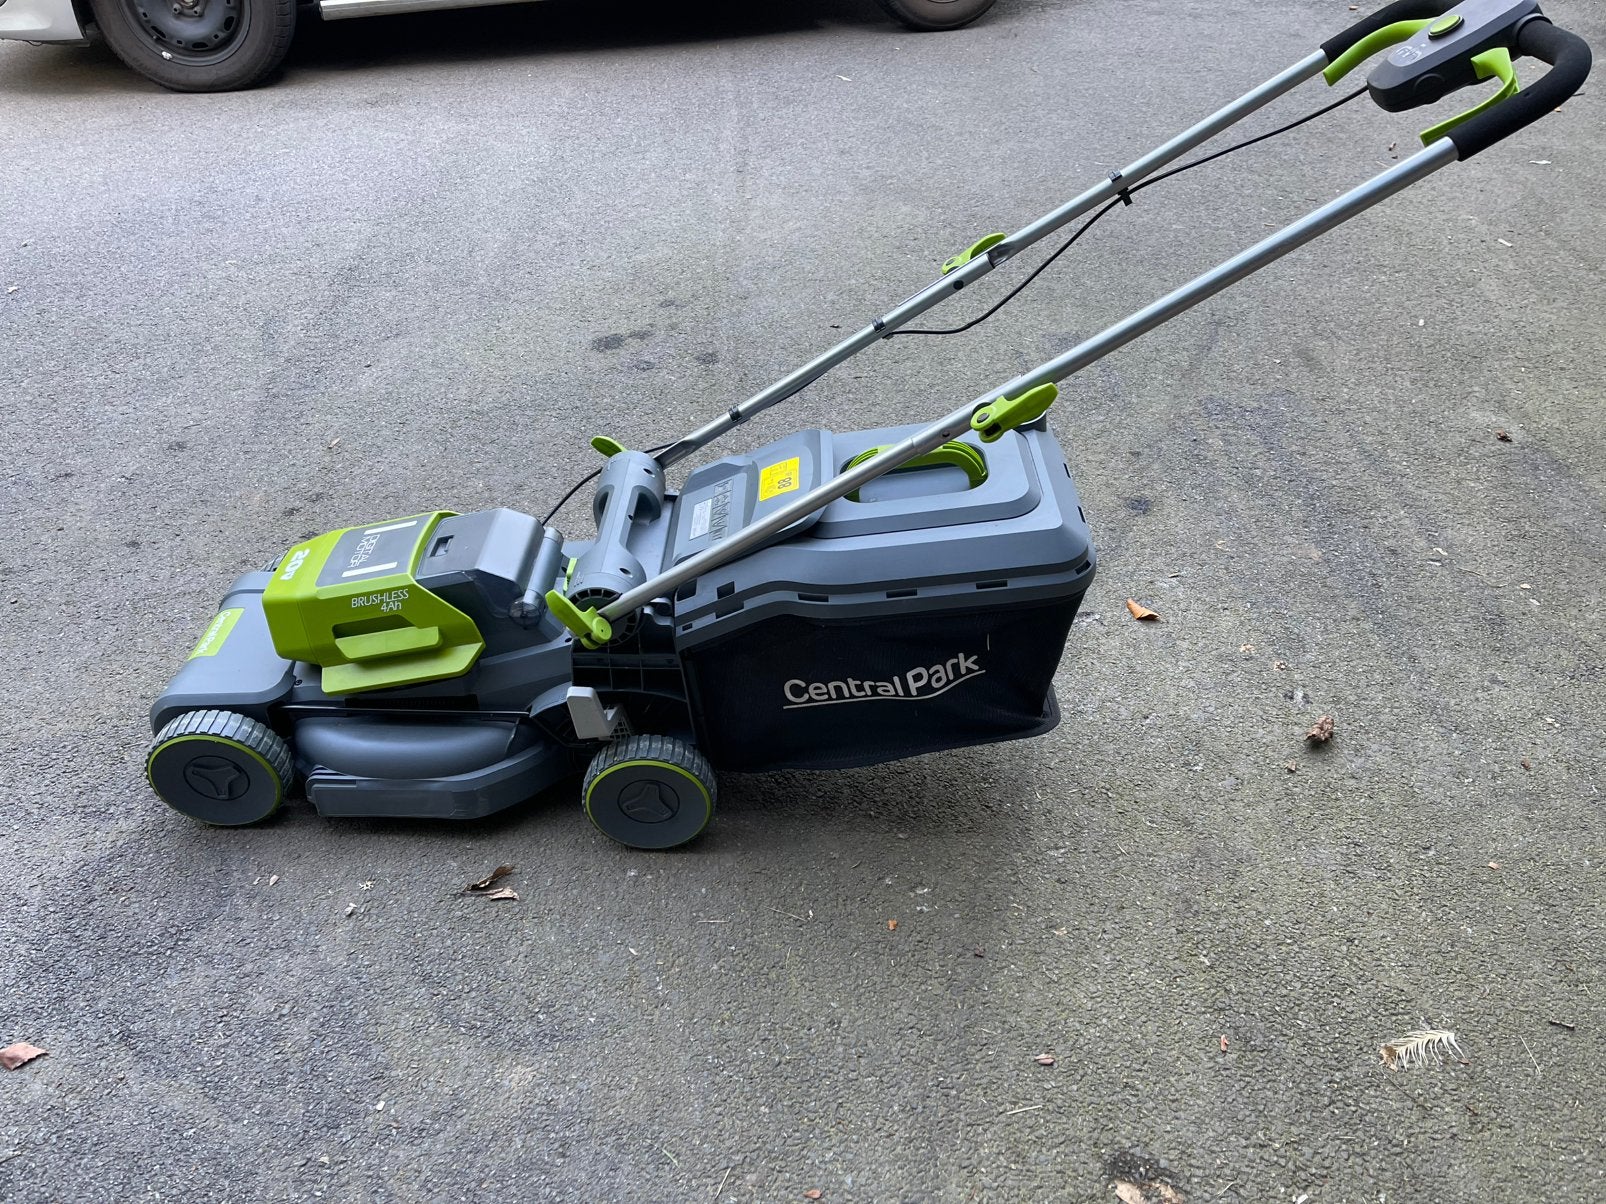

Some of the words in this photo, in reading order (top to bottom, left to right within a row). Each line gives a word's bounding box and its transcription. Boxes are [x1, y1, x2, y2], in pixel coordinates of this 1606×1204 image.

[777, 477, 793, 490] 88
[348, 535, 370, 568] MOTOR
[351, 588, 409, 608] BRUSHLESS
[380, 601, 402, 613] 4Ah
[784, 676, 904, 704] Central
[906, 653, 980, 696] Park
